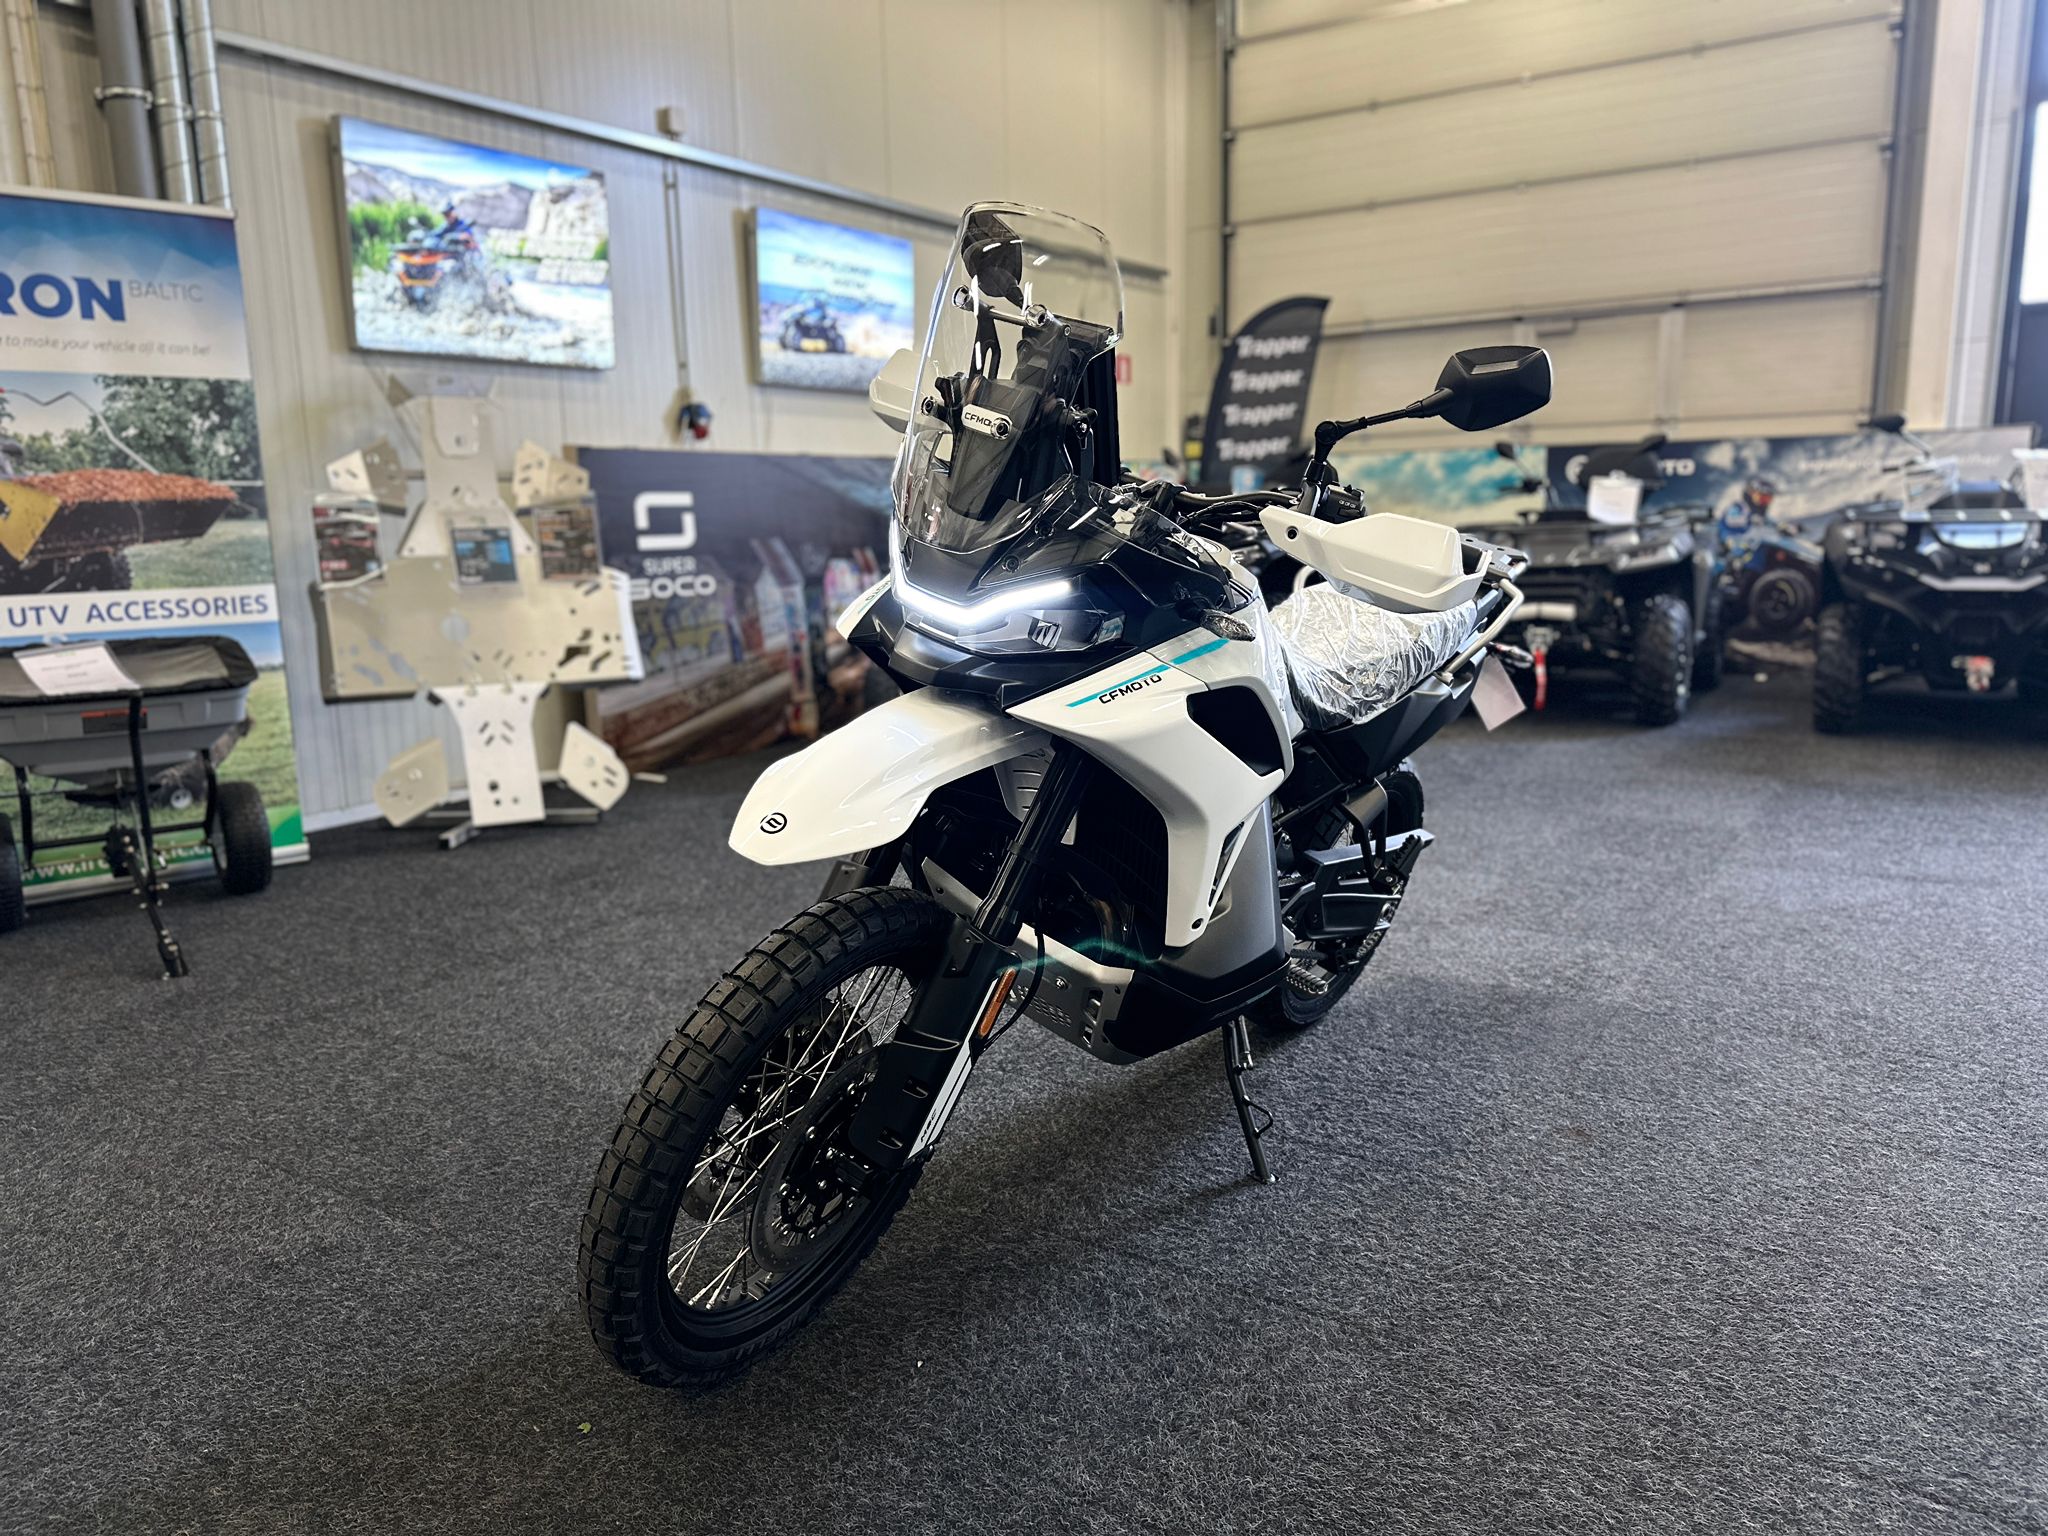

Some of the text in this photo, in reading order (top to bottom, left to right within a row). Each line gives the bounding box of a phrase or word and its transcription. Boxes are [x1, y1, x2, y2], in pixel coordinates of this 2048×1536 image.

[129, 279, 204, 303] BALTIC
[5, 335, 20, 347] to
[22, 335, 58, 348] make
[62, 338, 90, 351] your
[93, 339, 136, 353] vehicle
[168, 344, 190, 355] can
[1236, 334, 1311, 359] Trapper
[1230, 368, 1304, 393] Trapper
[965, 412, 996, 427] CFMO
[1223, 402, 1298, 427] Trapper
[1217, 435, 1292, 461] Trapper
[643, 556, 697, 576] SUPER
[631, 574, 717, 601] SOCO
[8, 593, 270, 628] UTV ACCESSORIES
[1099, 674, 1163, 704] CFMOTO
